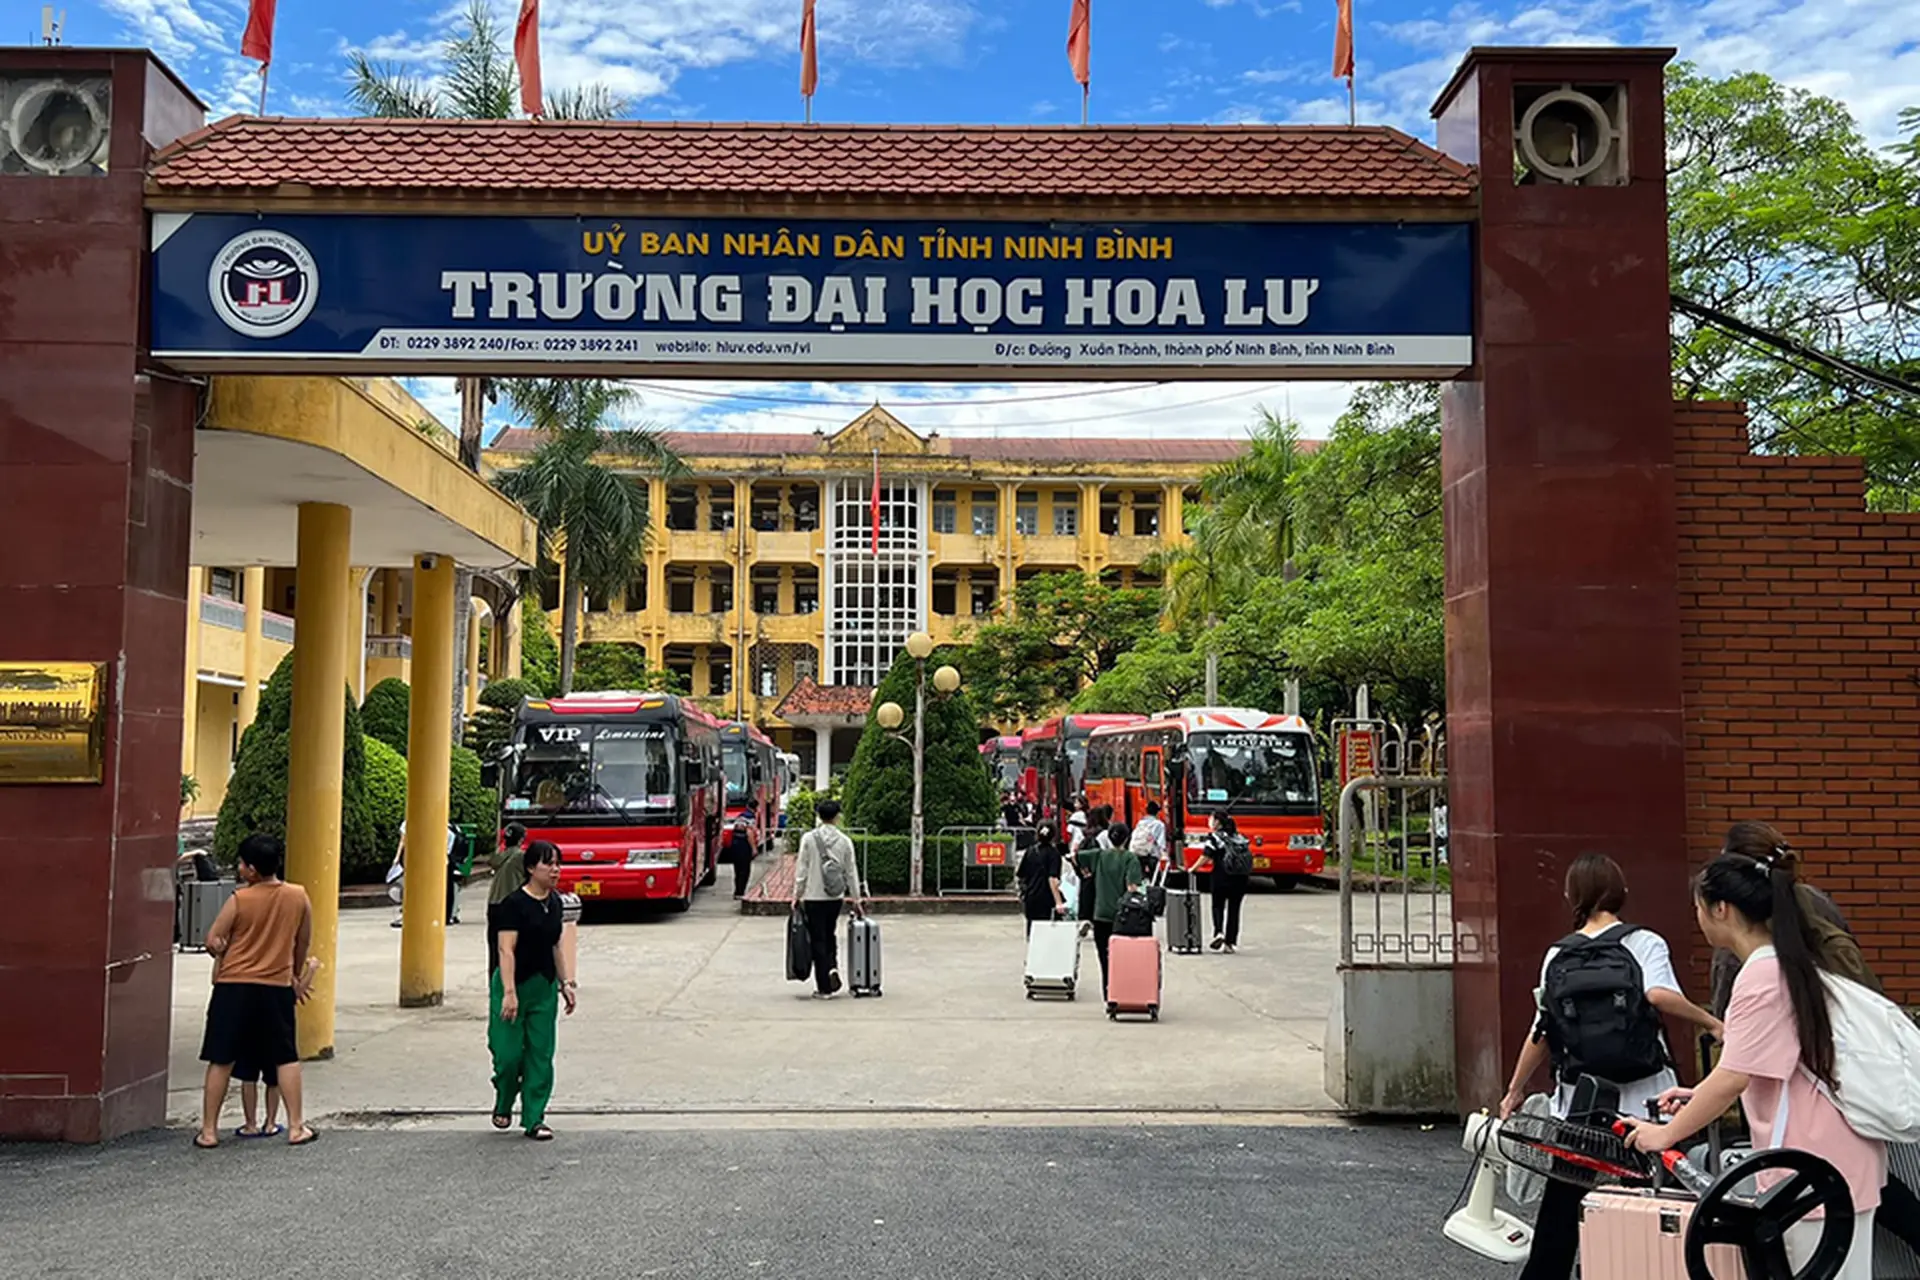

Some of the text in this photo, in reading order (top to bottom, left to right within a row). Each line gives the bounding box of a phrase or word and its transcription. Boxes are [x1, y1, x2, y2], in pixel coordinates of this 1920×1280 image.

[583, 224, 1173, 260] UỶ BAN NHÂN DÂN TỈNH NINH BÌNH
[440, 260, 1319, 333] TRƯỜNG ĐẠI HỌC HOA LƯ
[407, 336, 438, 350] 0229
[443, 336, 475, 350] 3892
[543, 337, 577, 351] 0229
[579, 338, 611, 352] 3892
[615, 339, 638, 351] 241
[655, 340, 711, 353] website:
[716, 341, 811, 354] hluv.edu.vn/vi
[995, 343, 1025, 357] Đ/c:
[1206, 340, 1233, 358] phố
[1235, 343, 1265, 356] Ninh
[1333, 343, 1363, 356] Ninh
[1366, 342, 1395, 356] Bình
[539, 727, 666, 742] VIP Limousine
